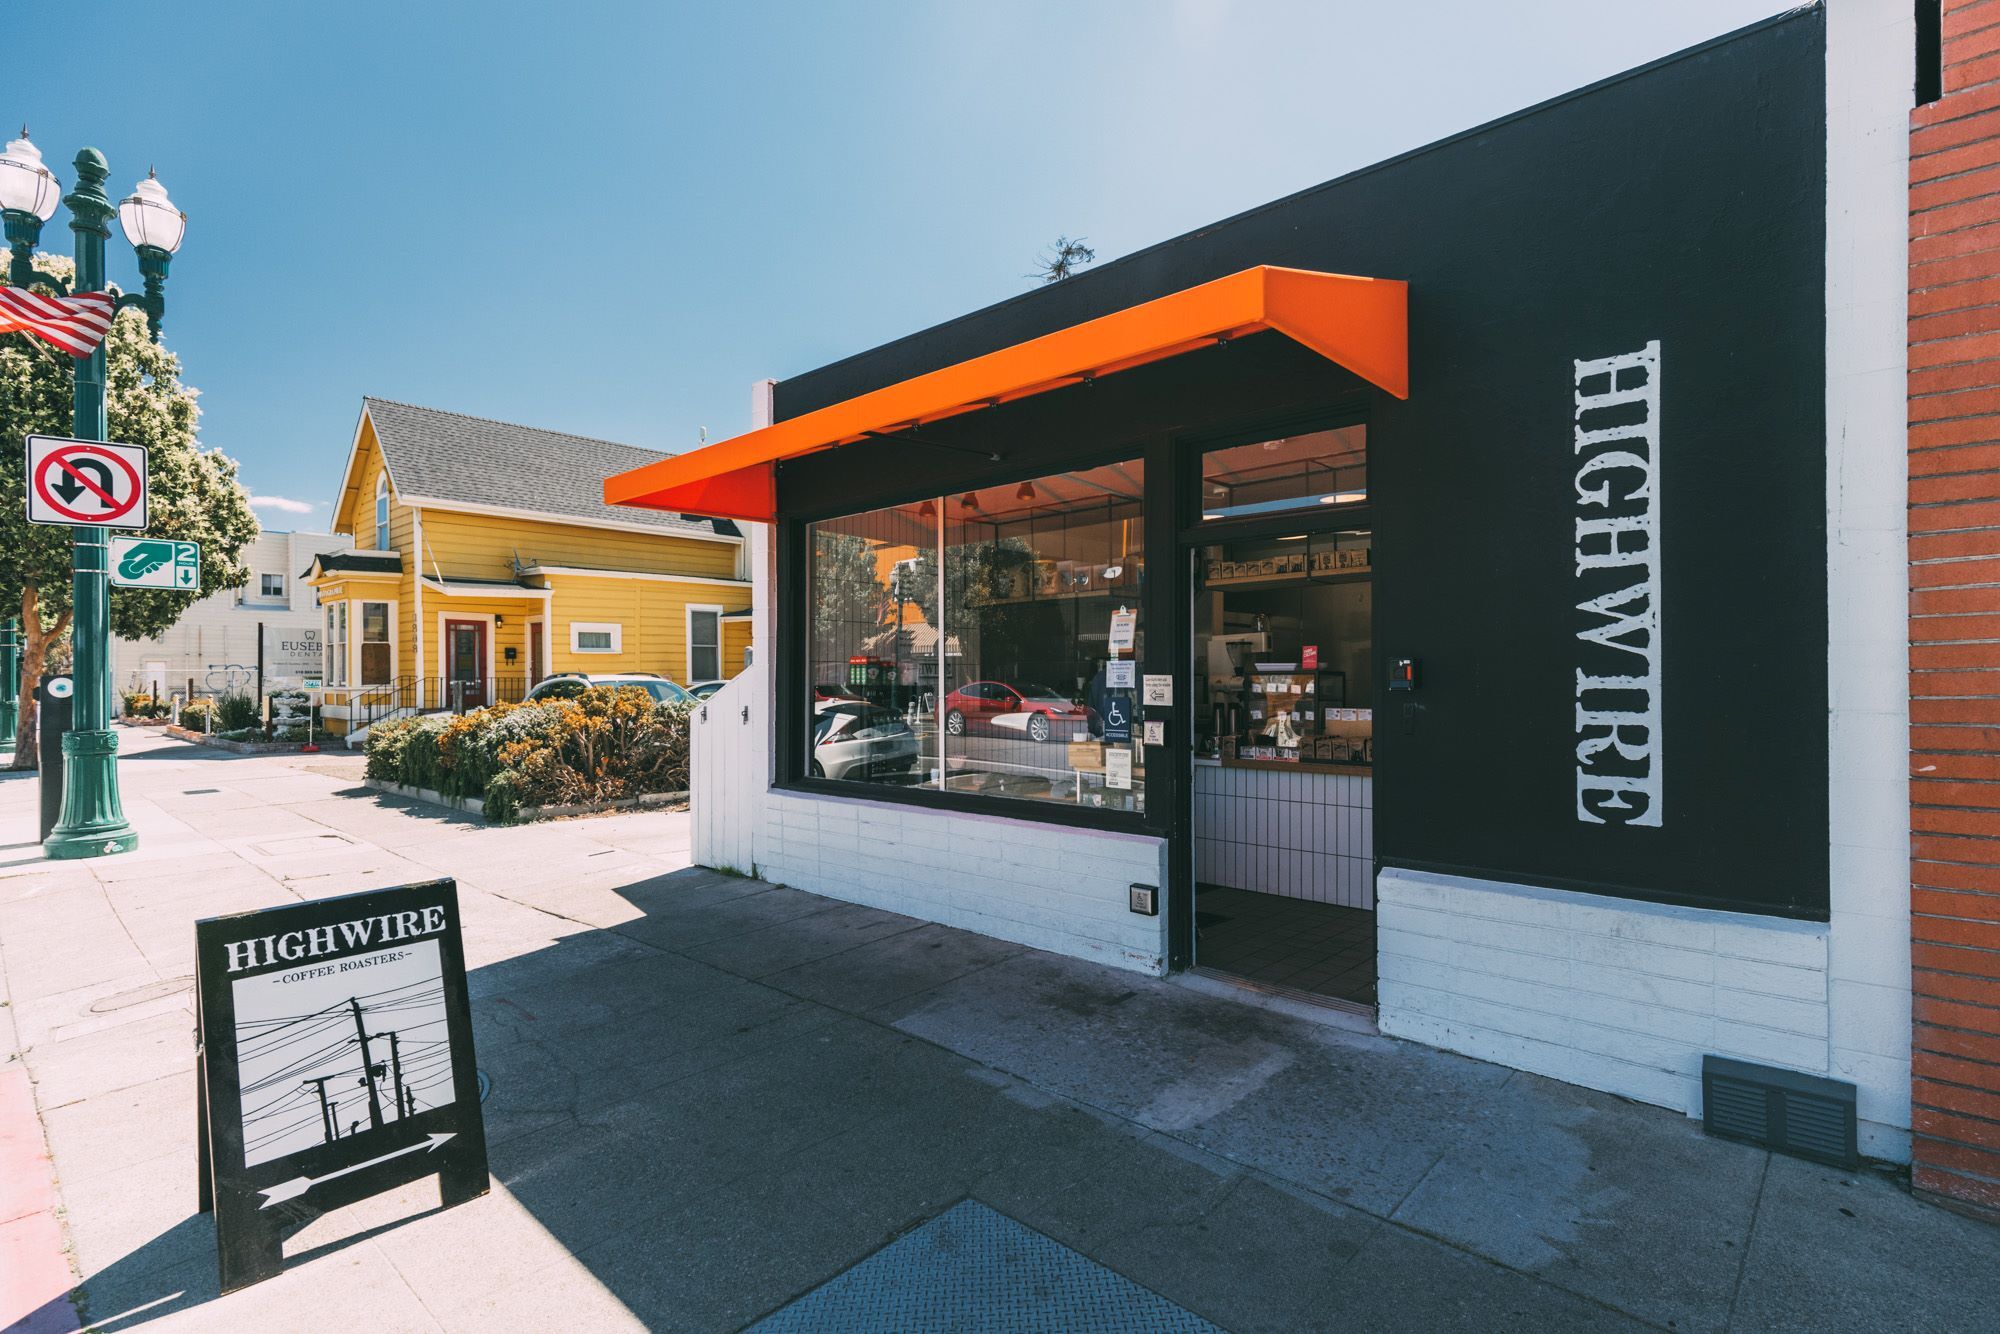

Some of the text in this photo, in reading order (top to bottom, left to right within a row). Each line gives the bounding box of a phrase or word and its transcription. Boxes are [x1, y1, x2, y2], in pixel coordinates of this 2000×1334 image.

[177, 544, 196, 562] 2
[1574, 340, 1662, 827] HIGHWIRE
[224, 905, 447, 973] HIGHWIRE
